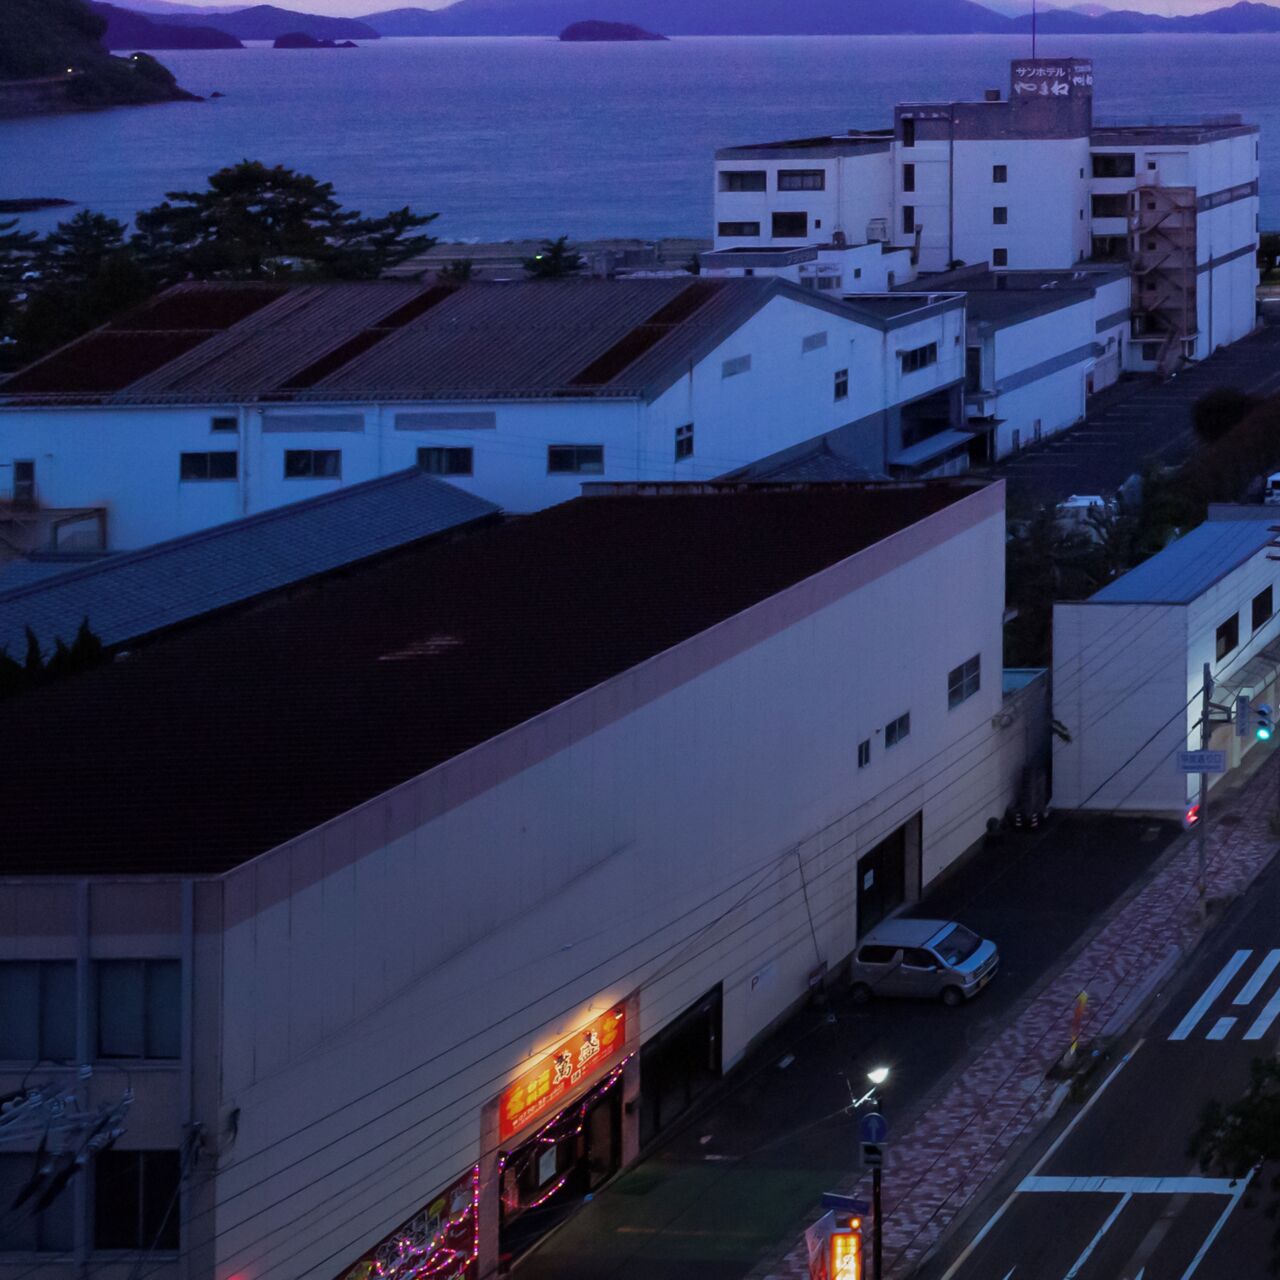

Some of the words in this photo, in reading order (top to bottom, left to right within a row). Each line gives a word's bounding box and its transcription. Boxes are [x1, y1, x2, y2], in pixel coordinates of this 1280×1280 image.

[1015, 67, 1066, 77] サンホテル
[751, 975, 759, 992] P
